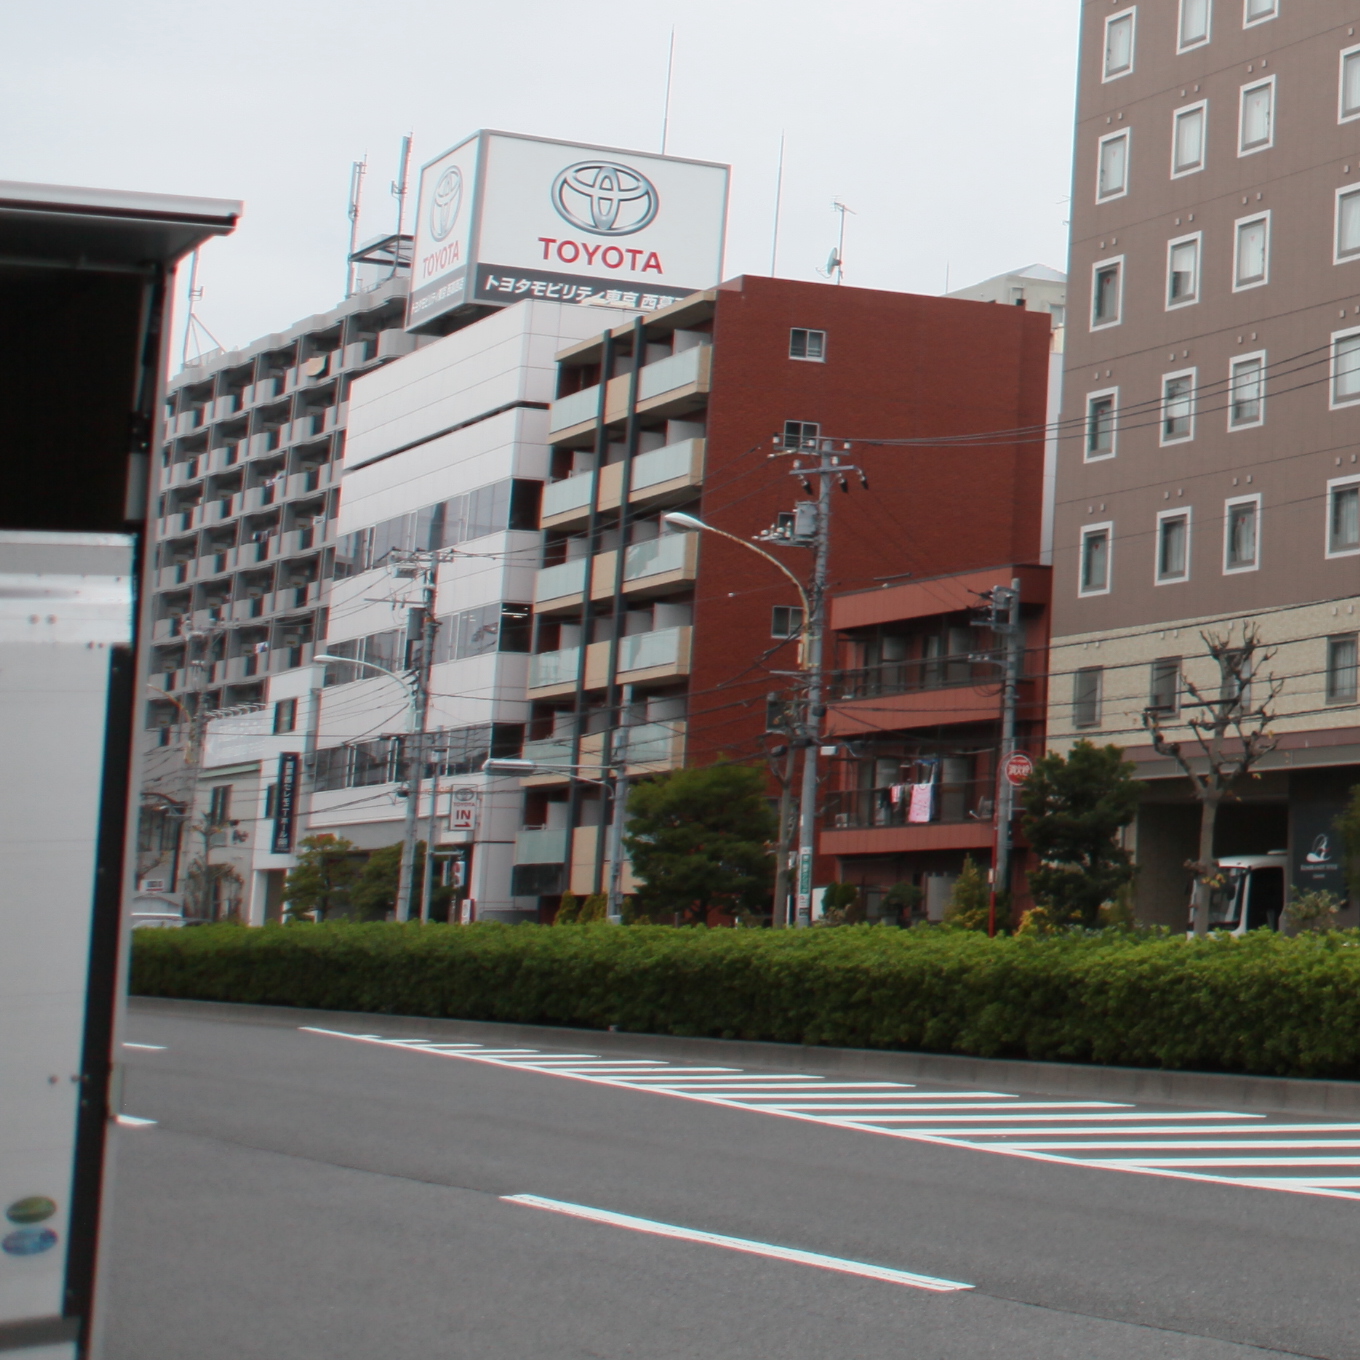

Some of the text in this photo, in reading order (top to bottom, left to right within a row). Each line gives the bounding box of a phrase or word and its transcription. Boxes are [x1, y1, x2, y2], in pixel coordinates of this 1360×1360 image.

[423, 240, 459, 278] TOYOTA
[538, 237, 664, 274] TOYOTA
[456, 809, 471, 820] IN
